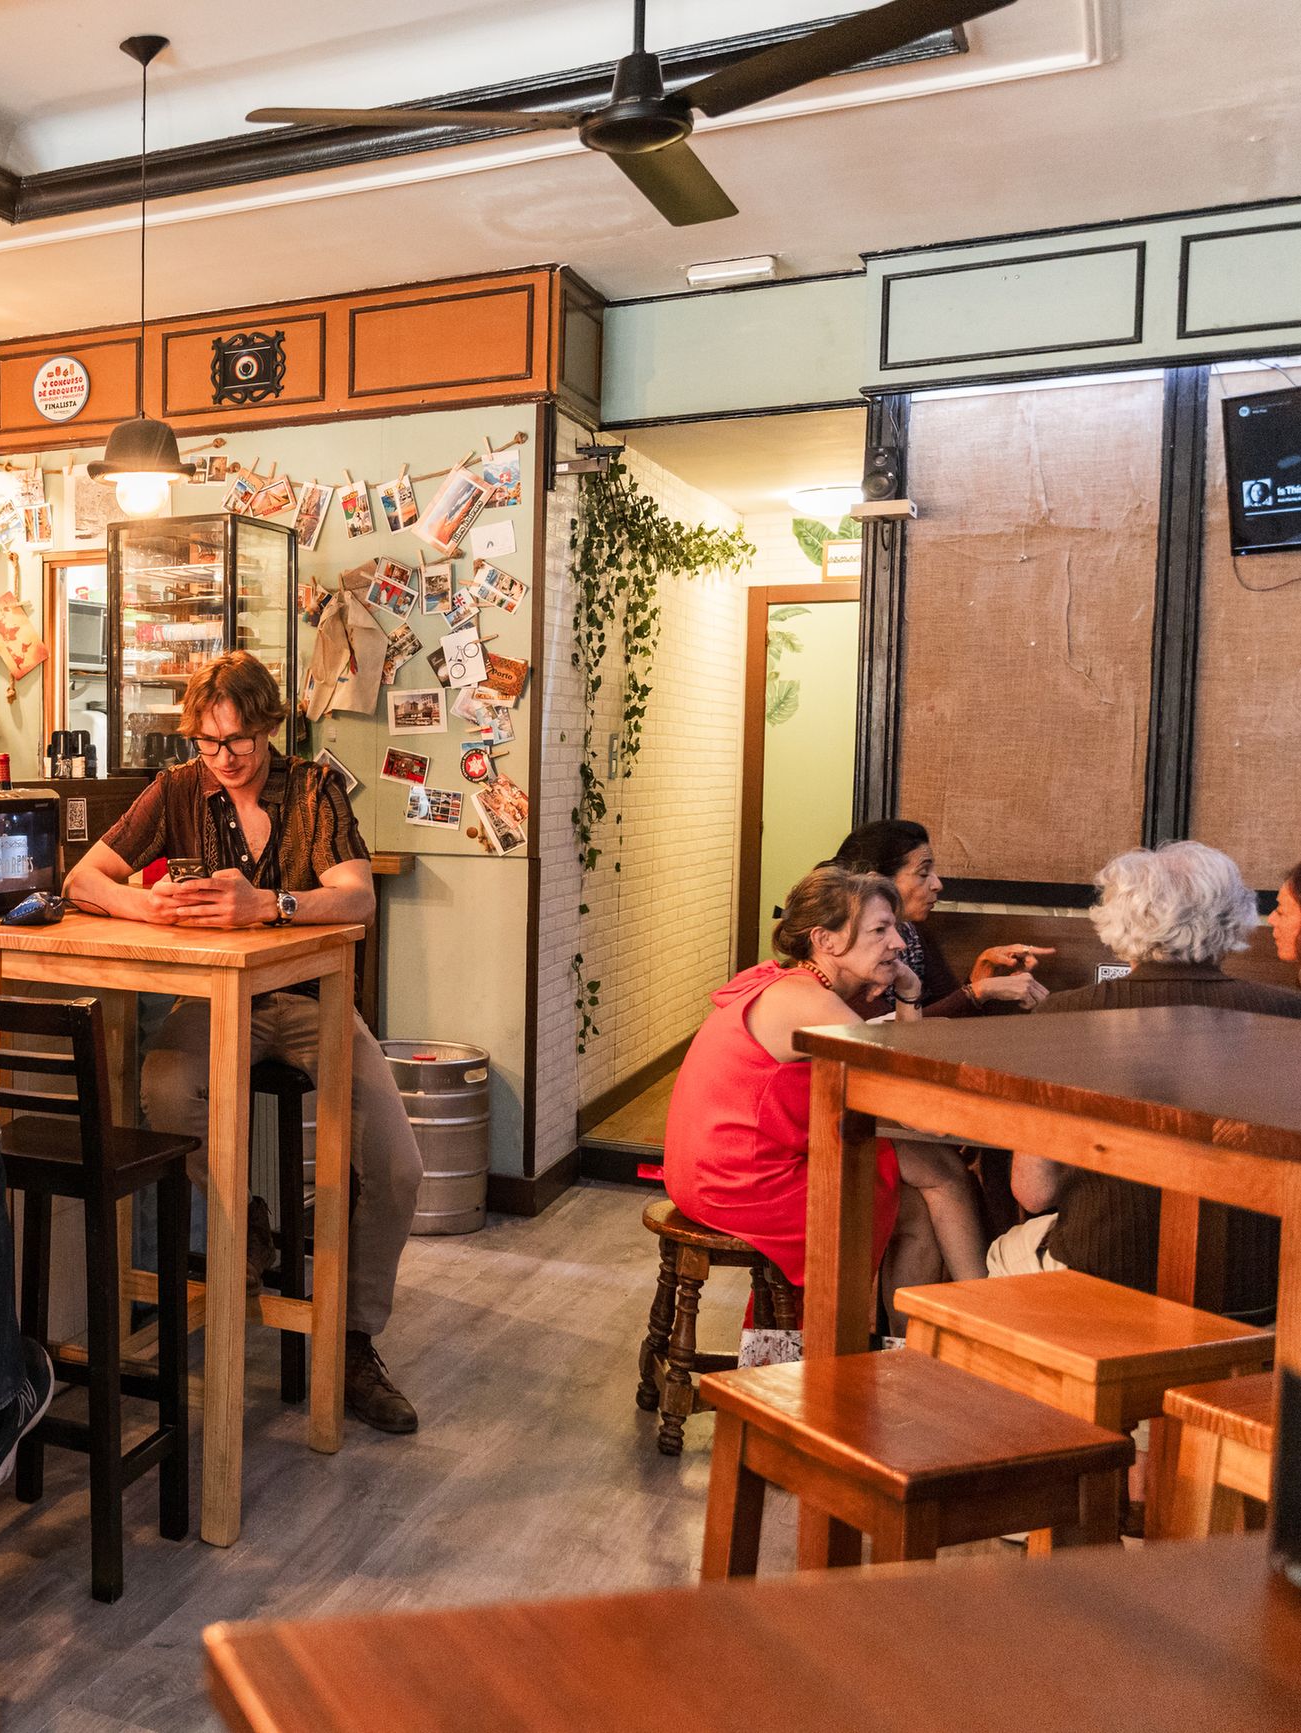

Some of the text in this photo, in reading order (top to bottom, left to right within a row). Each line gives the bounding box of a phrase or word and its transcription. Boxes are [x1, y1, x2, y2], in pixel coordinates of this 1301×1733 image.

[50, 377, 83, 387] CONCURSO
[49, 385, 85, 396] CROQUETAS
[44, 401, 77, 410] FINALISTA
[491, 668, 513, 681] Porto
